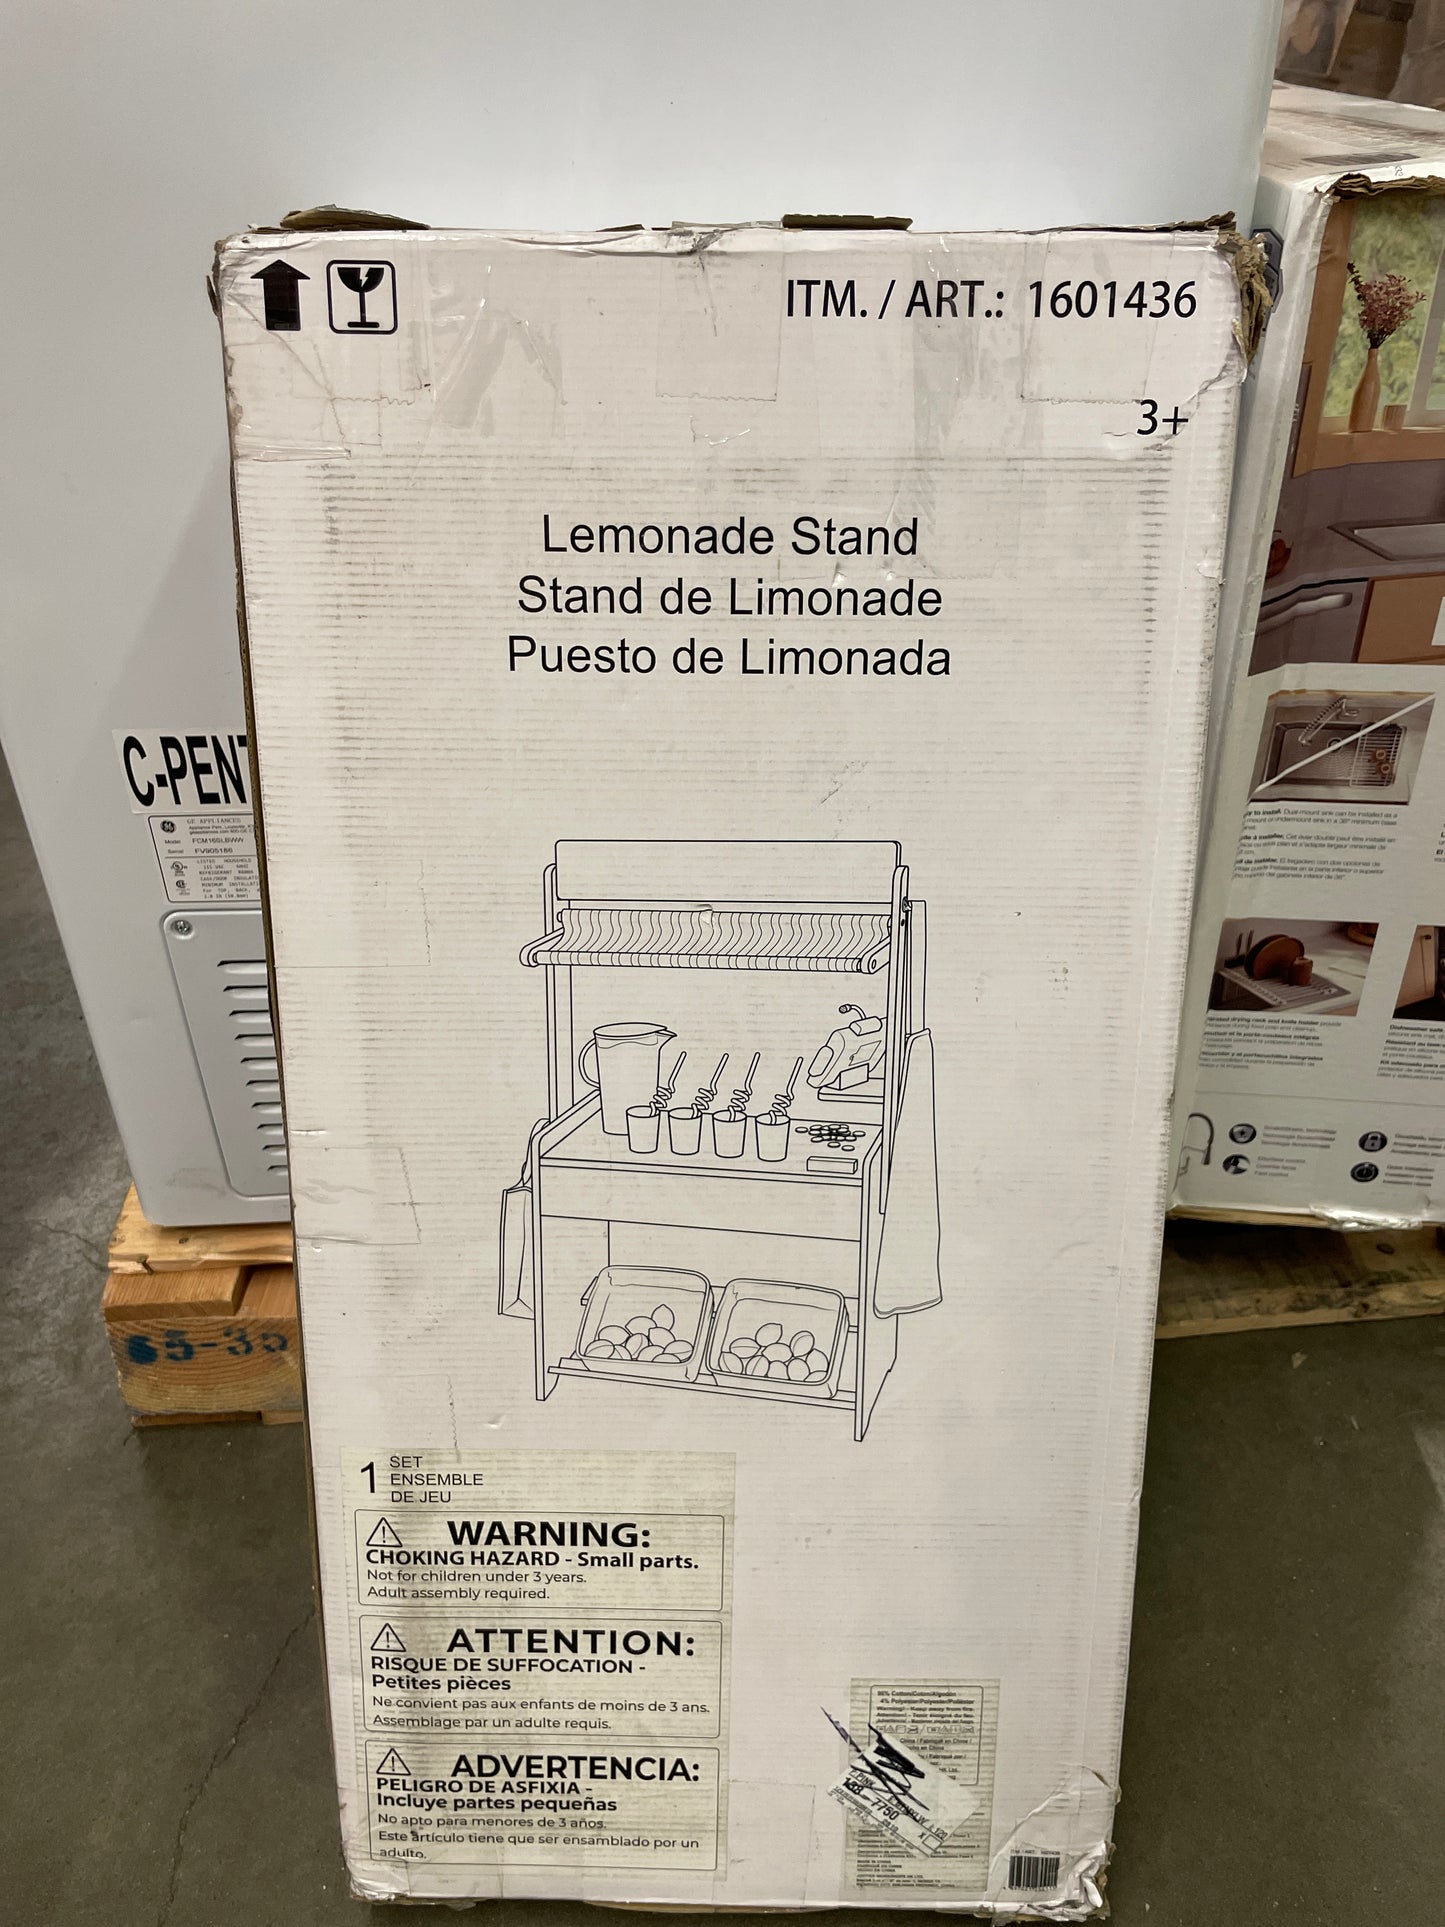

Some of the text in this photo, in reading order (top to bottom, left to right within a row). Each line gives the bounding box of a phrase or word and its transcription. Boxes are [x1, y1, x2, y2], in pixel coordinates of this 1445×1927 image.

[788, 279, 1197, 319] ITM. / ART.: 1601436
[1136, 400, 1189, 435] 3+
[545, 515, 918, 555] Lemonade Stand
[519, 576, 942, 616] Stand de Limonade
[509, 636, 951, 676] Puesto de Limonada
[390, 1456, 423, 1468] SET
[360, 1461, 376, 1494] 1
[391, 1474, 484, 1486] ENSEMBLE
[391, 1491, 452, 1503] DE JEU
[447, 1521, 650, 1548] WARNING:
[366, 1550, 465, 1565] CHOKING
[471, 1551, 559, 1566] HAZARD
[578, 1552, 633, 1568] Small
[640, 1554, 699, 1571] parts.
[367, 1570, 586, 1585] Not for children under 3 years.
[367, 1586, 549, 1601] Adult assembly required.
[447, 1628, 695, 1656] ATTENTION:
[371, 1657, 447, 1673] RISQUE
[453, 1658, 482, 1672] DE
[487, 1659, 632, 1673] SUFFOCATION
[372, 1674, 511, 1692] Petites pièces
[373, 1696, 710, 1713] Ne convient pas aux enfants de moins de 3 ans.
[373, 1715, 611, 1731] Assemblage par un adulte requis.
[451, 1754, 699, 1782] ADVERTENCIA:
[377, 1778, 463, 1793] PELIGRO
[469, 1781, 496, 1793] DE
[501, 1781, 580, 1794] ASFIXIA
[377, 1793, 617, 1812] Incluye partes pequeñas
[378, 1813, 607, 1829] No apto para menores de 3 años.
[379, 1831, 407, 1842] Este
[468, 1833, 504, 1843] tiene
[507, 1834, 534, 1846] que
[538, 1834, 558, 1845] ser
[562, 1835, 649, 1848] ensamblado
[653, 1837, 677, 1850] por
[681, 1838, 699, 1848] un
[379, 1848, 427, 1859] adulto.
